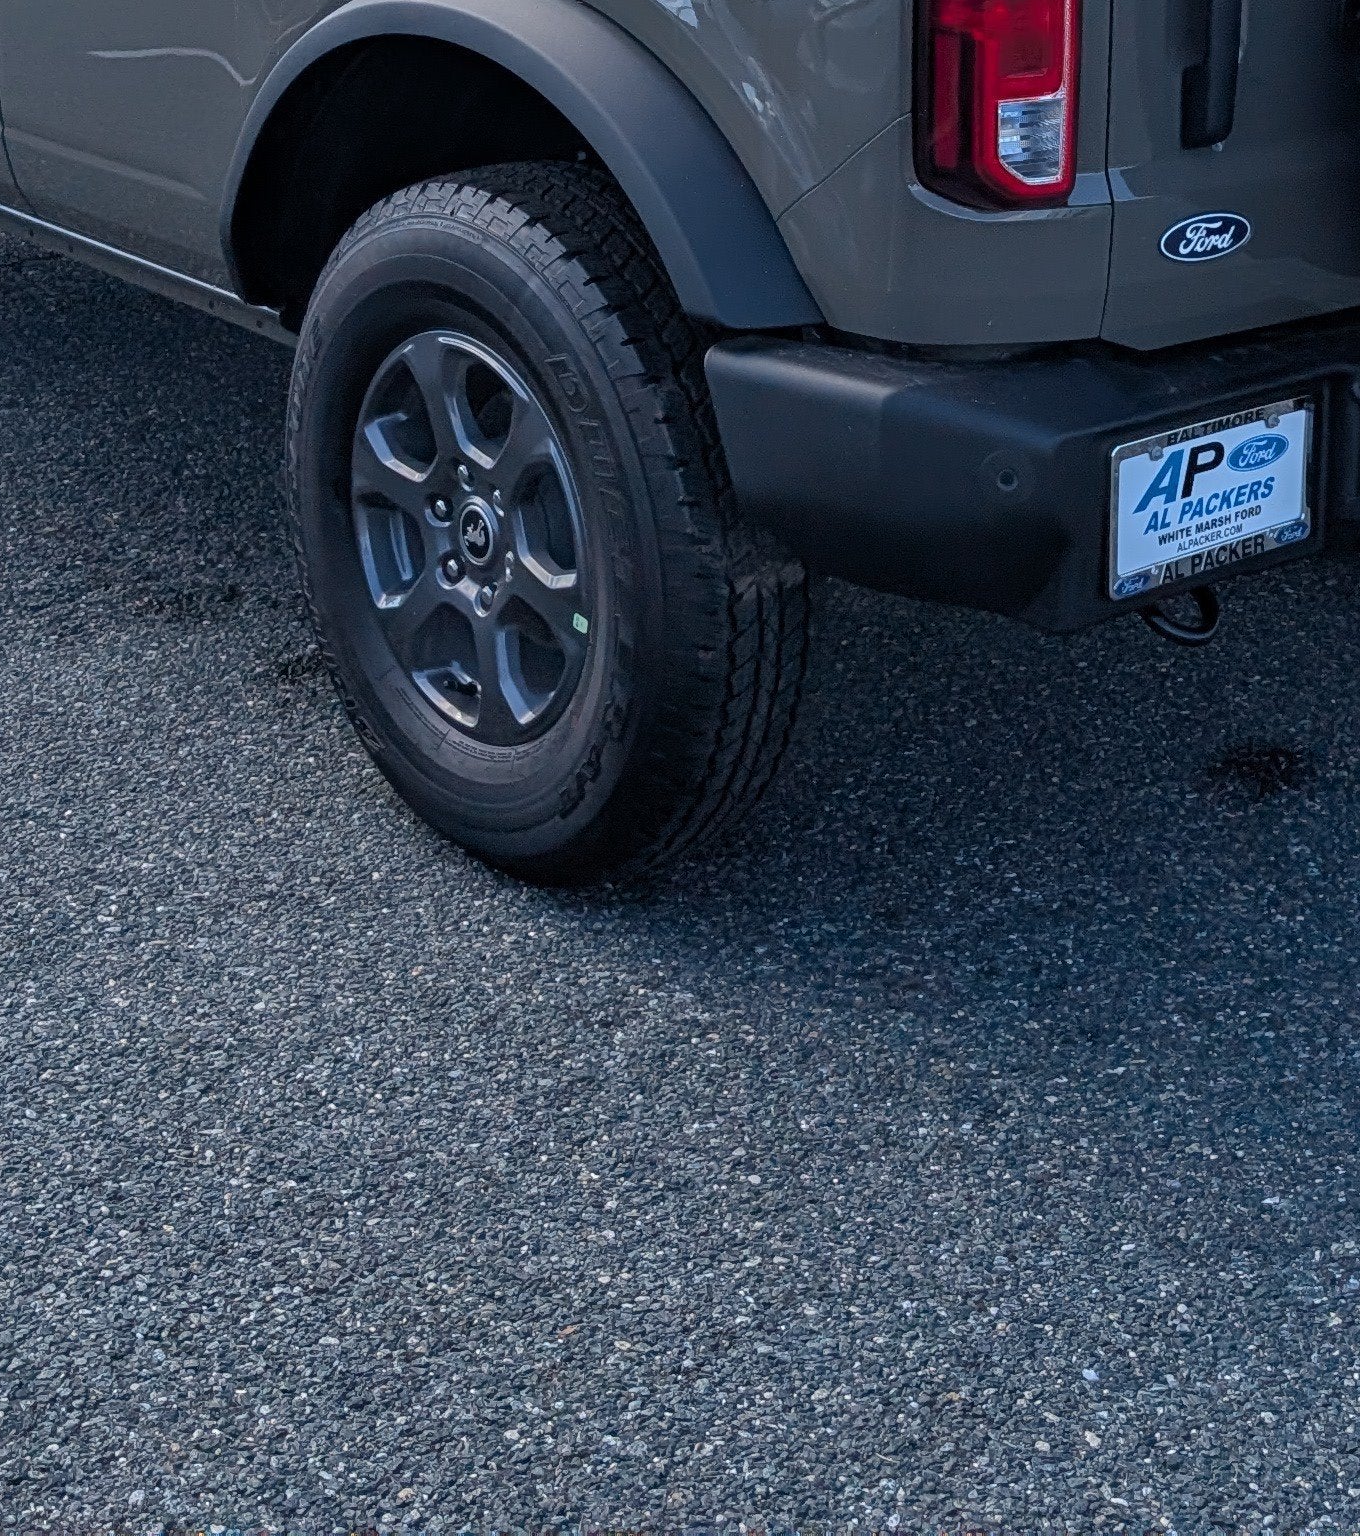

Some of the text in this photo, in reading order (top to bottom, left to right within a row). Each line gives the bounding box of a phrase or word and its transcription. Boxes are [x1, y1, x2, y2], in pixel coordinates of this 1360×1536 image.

[1174, 219, 1238, 257] Ford
[1166, 409, 1265, 446] BALTIMORE
[1237, 439, 1279, 469] Ford
[1133, 441, 1225, 515] AP
[1143, 476, 1275, 535] AL PACKERS
[1158, 504, 1262, 546] WHITE MARSH FORD
[1177, 523, 1243, 553] ALPACKER.COM
[1161, 533, 1265, 584] AL PACKER
